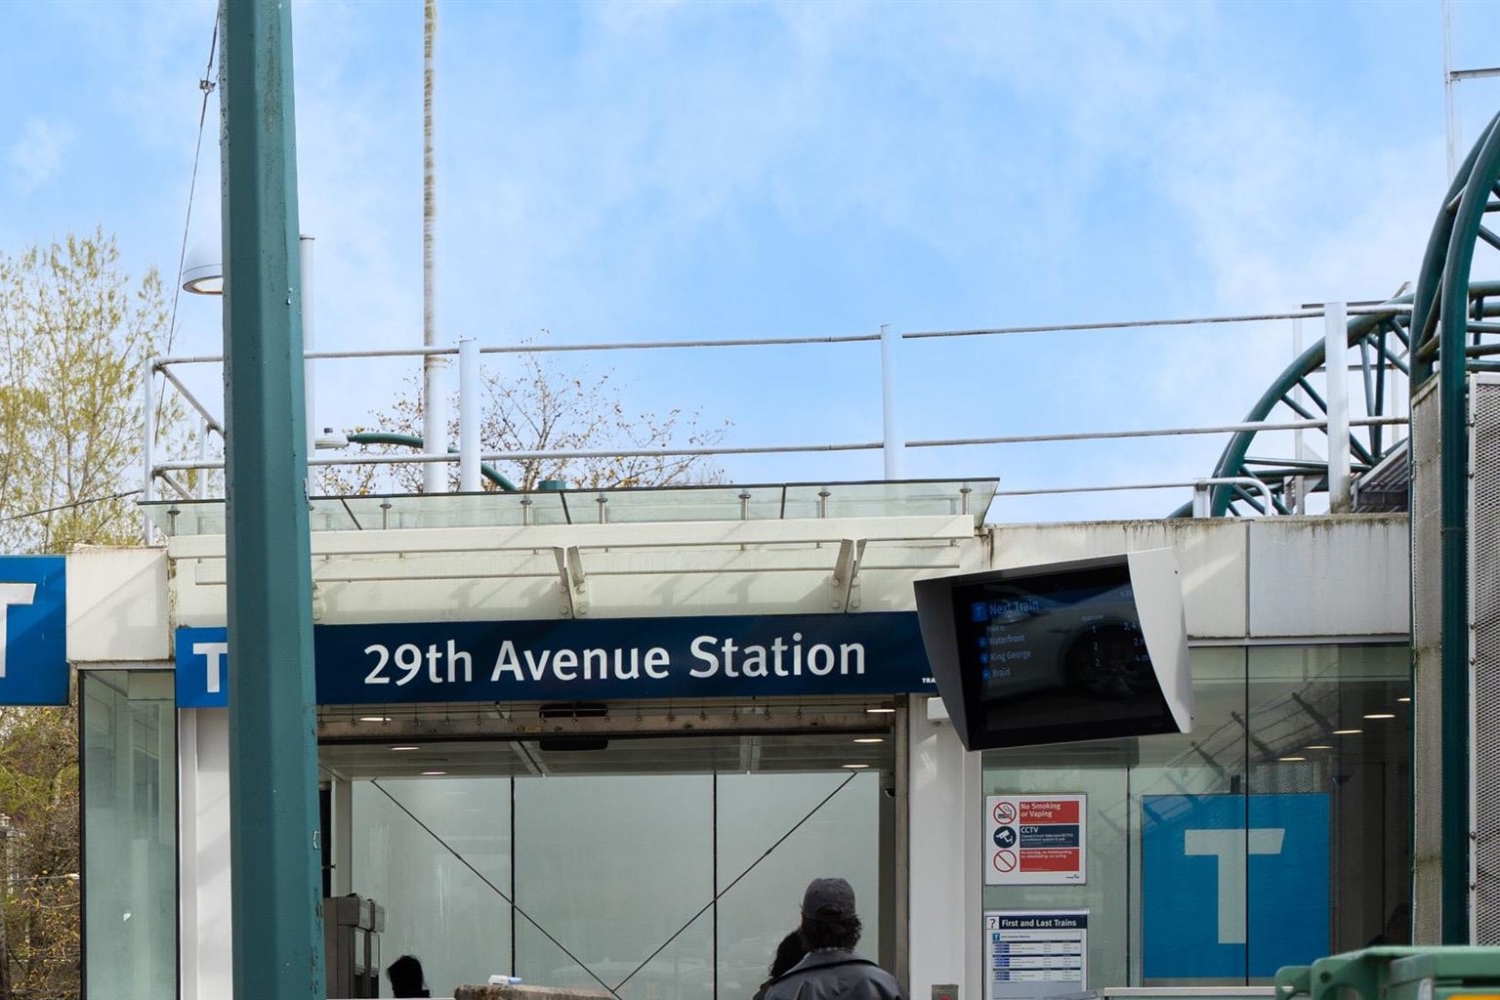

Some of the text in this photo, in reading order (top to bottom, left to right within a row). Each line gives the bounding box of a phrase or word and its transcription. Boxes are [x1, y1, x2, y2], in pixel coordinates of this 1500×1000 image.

[989, 602, 1012, 616] Next
[1013, 600, 1039, 613] Train
[364, 633, 865, 686] 29th Avenue Station
[990, 652, 1006, 663] King
[1007, 650, 1032, 660] George
[193, 642, 227, 693] T
[1032, 802, 1061, 811] Smoking
[1029, 810, 1053, 818] Vaping
[1021, 826, 1039, 834] CCTV
[1184, 828, 1285, 944] T
[1001, 919, 1019, 927] First
[1021, 918, 1035, 927] and
[1036, 918, 1053, 927] Last
[1054, 918, 1077, 927] Trains
